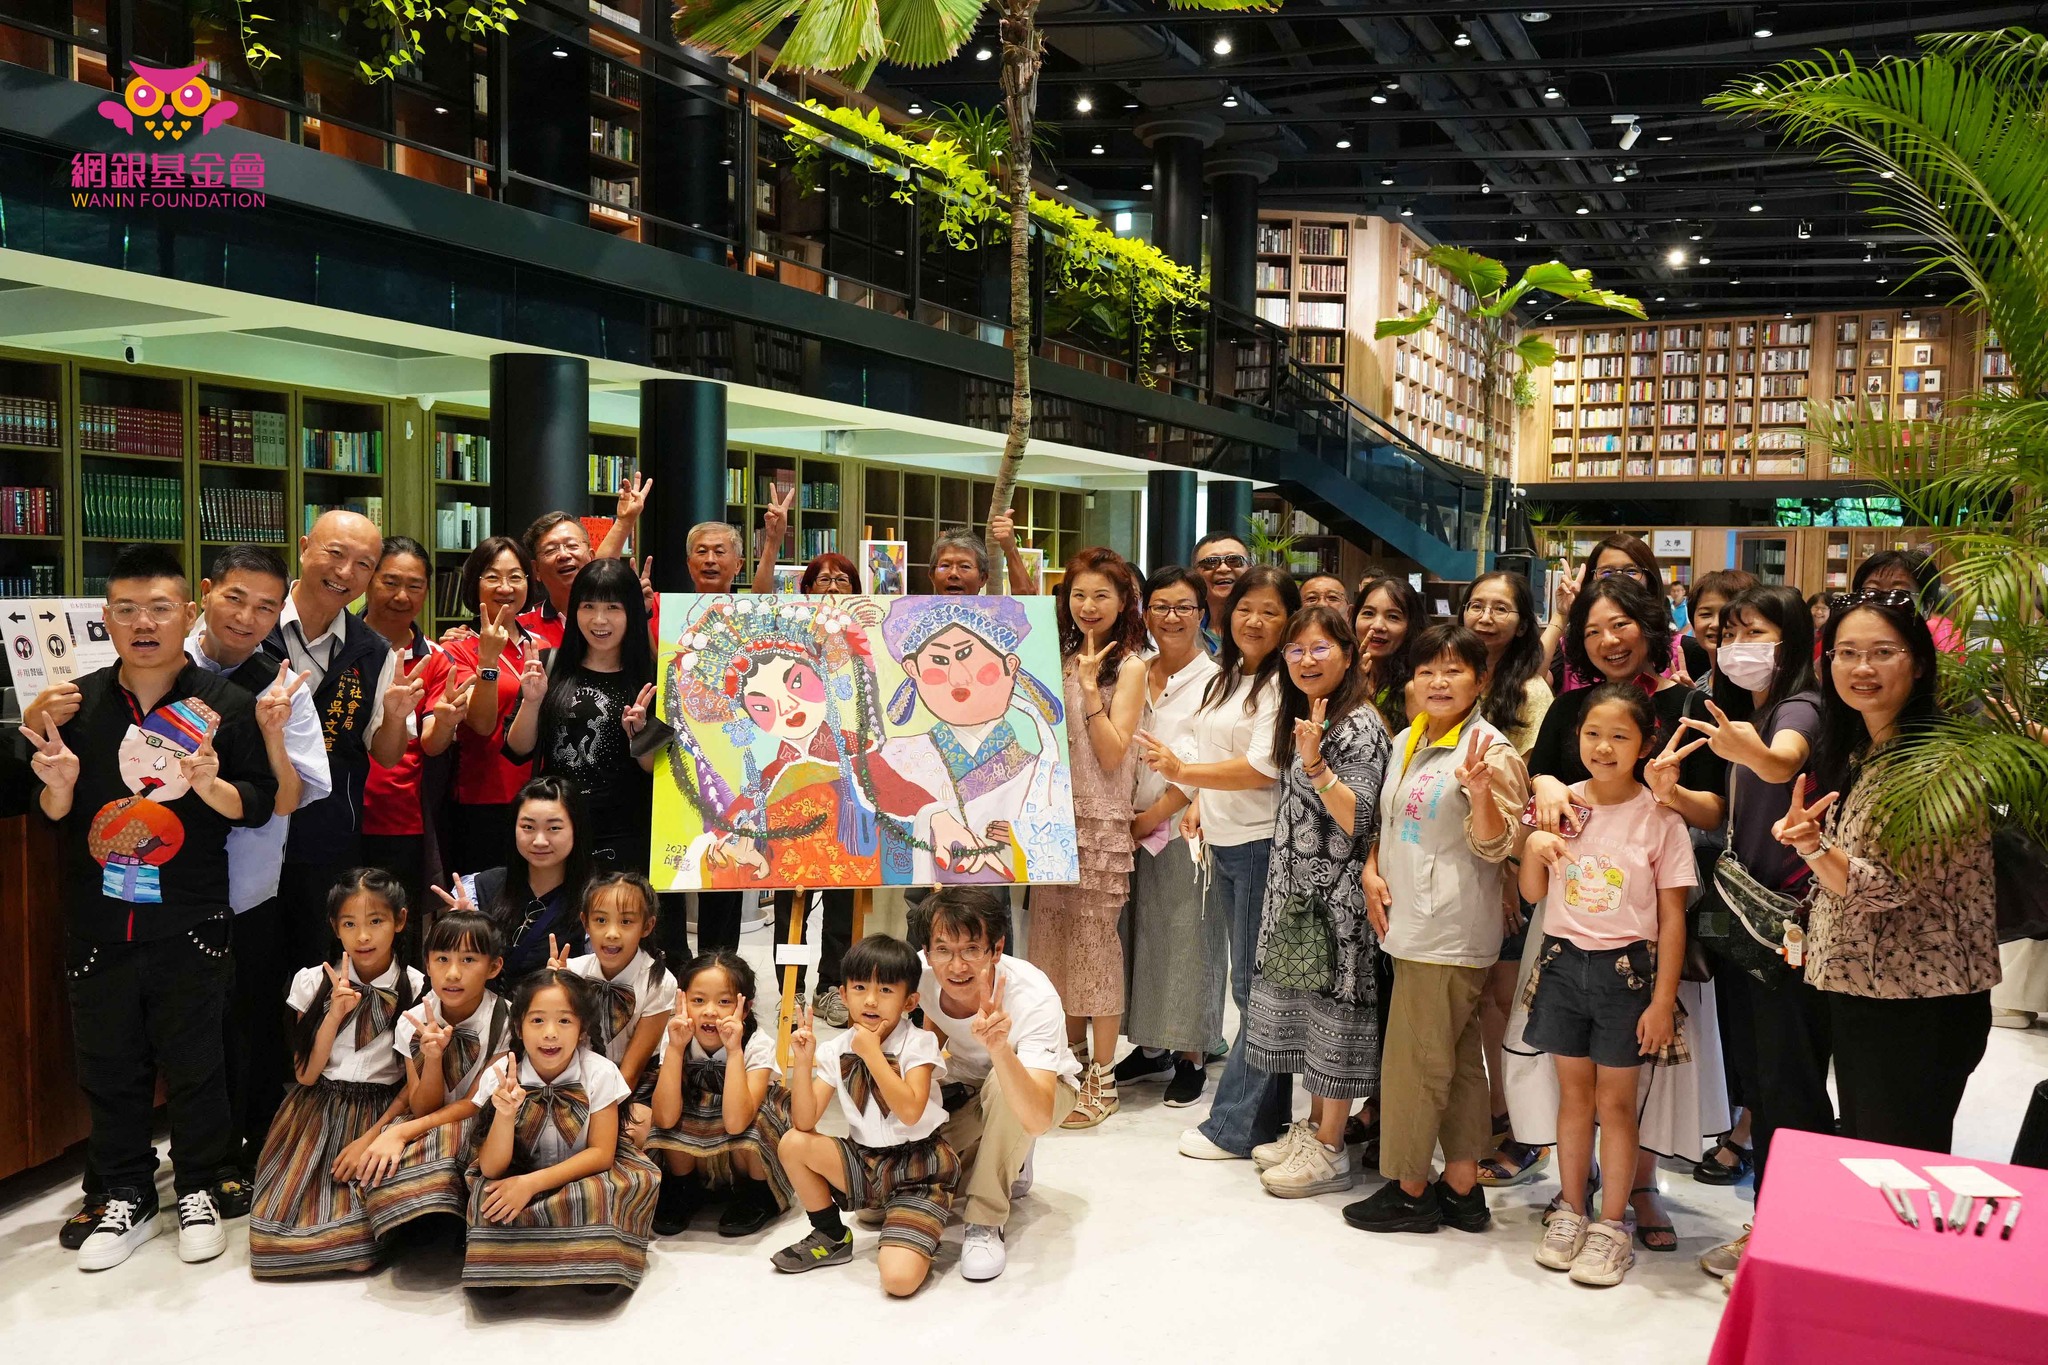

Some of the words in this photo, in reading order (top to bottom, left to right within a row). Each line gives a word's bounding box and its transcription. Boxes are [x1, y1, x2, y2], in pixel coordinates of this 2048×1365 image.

[342, 686, 362, 730] 社會局
[1405, 774, 1434, 820] 何欣純
[665, 844, 688, 856] 2023
